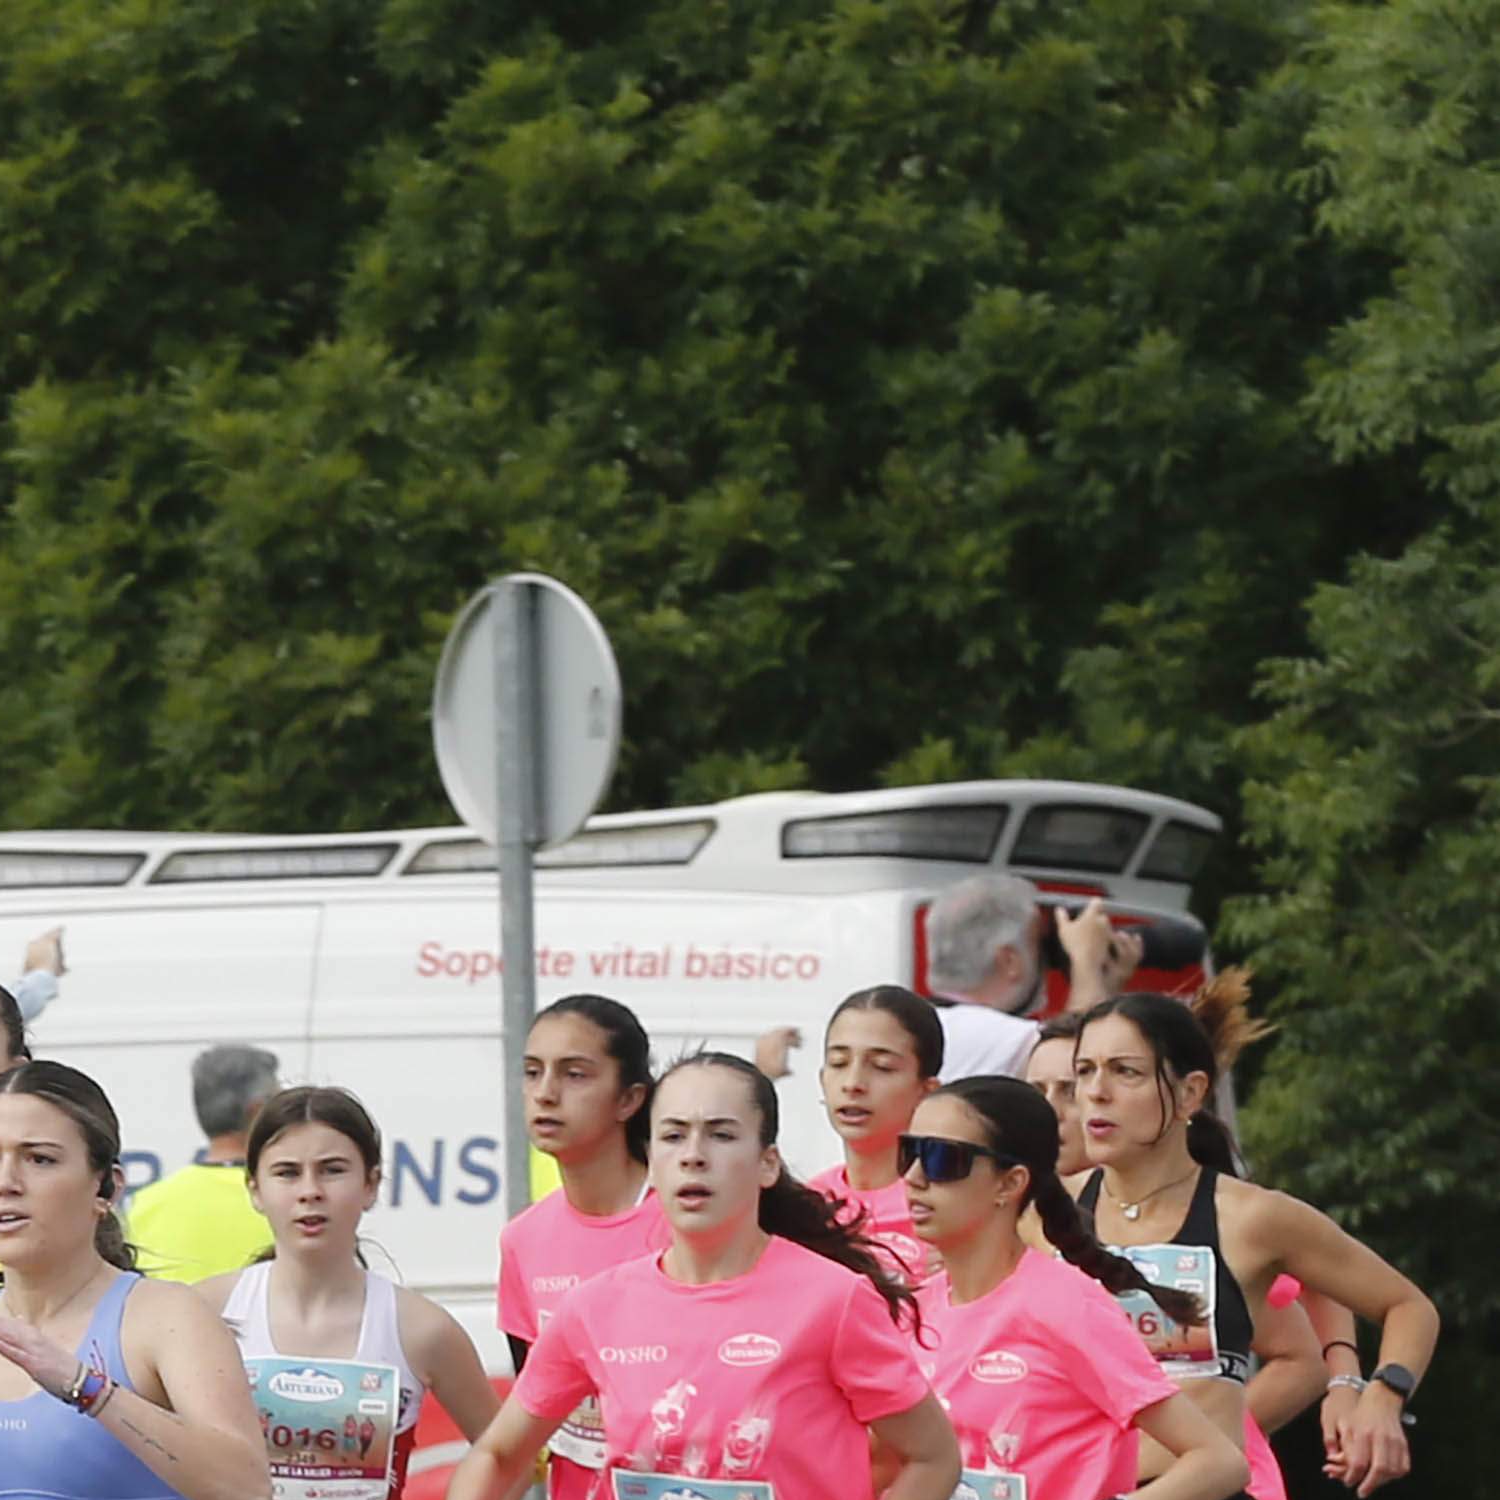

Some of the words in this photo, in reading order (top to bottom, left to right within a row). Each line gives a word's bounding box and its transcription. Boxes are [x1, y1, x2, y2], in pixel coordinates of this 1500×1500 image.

[416, 941, 575, 985] Sopte
[589, 943, 671, 978] vital
[683, 941, 822, 980] básico
[532, 1274, 581, 1293] OYSHO
[600, 1345, 668, 1365] OYSHO
[272, 1379, 341, 1396] ASTURIANA
[272, 1425, 337, 1450] 016
